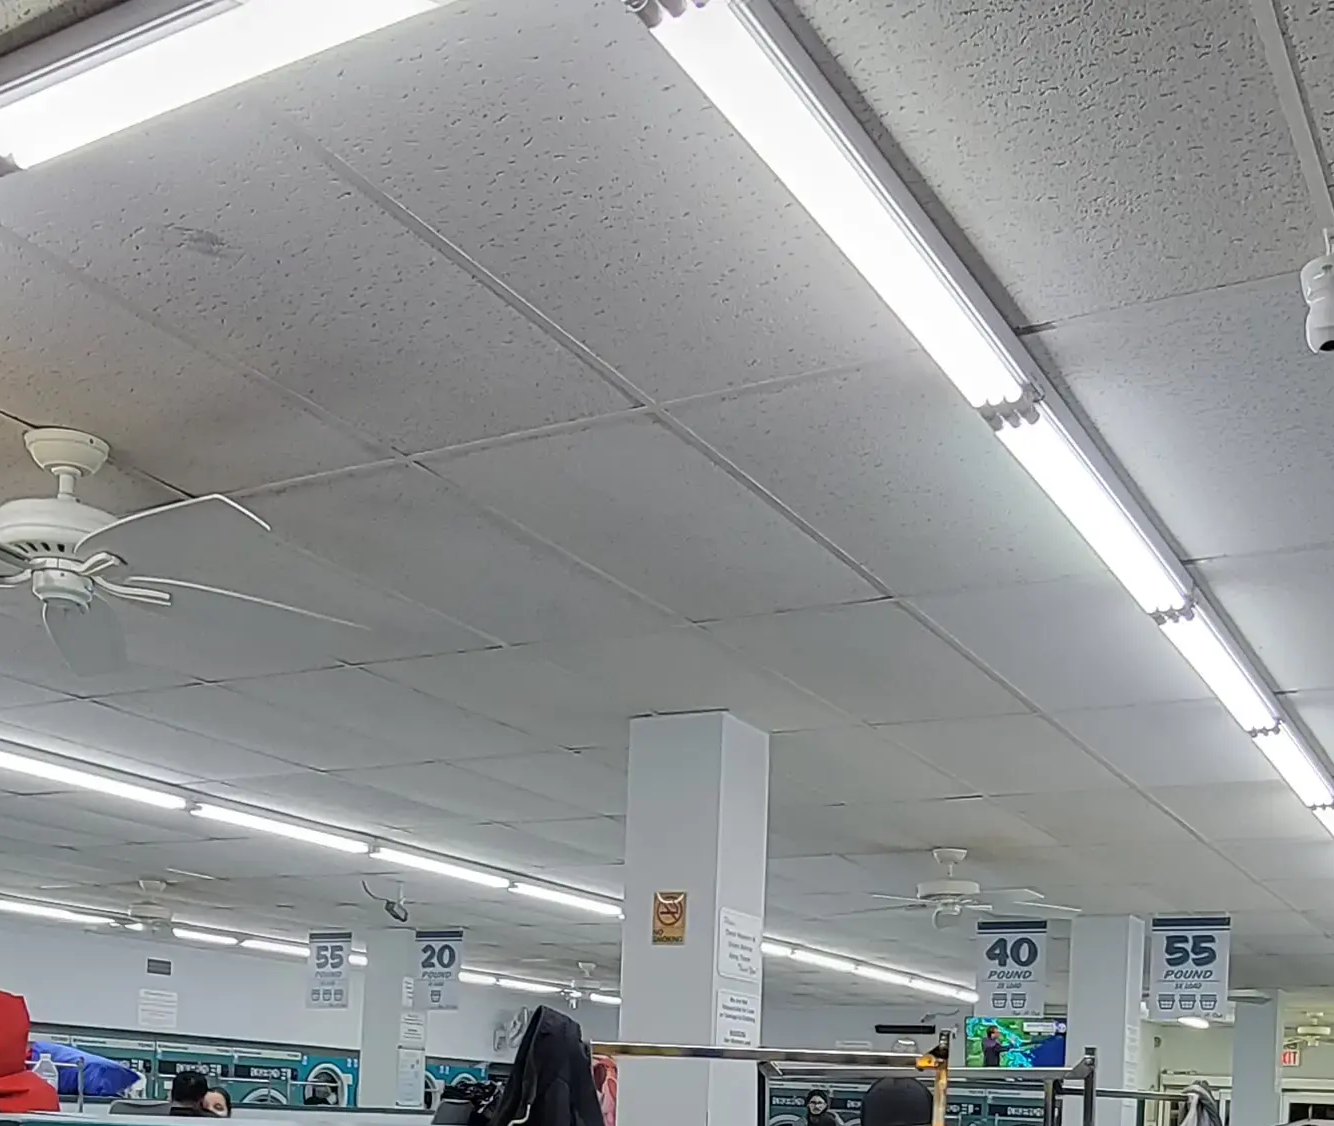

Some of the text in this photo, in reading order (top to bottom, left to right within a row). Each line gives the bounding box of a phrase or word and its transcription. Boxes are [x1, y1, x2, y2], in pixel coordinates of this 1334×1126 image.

[316, 945, 344, 969] 55
[421, 944, 456, 969] 20
[985, 937, 1038, 967] 40
[1164, 934, 1217, 967] 55
[988, 970, 1032, 979] POUND
[1164, 970, 1213, 979] POUND
[1281, 1051, 1298, 1065] XIT
